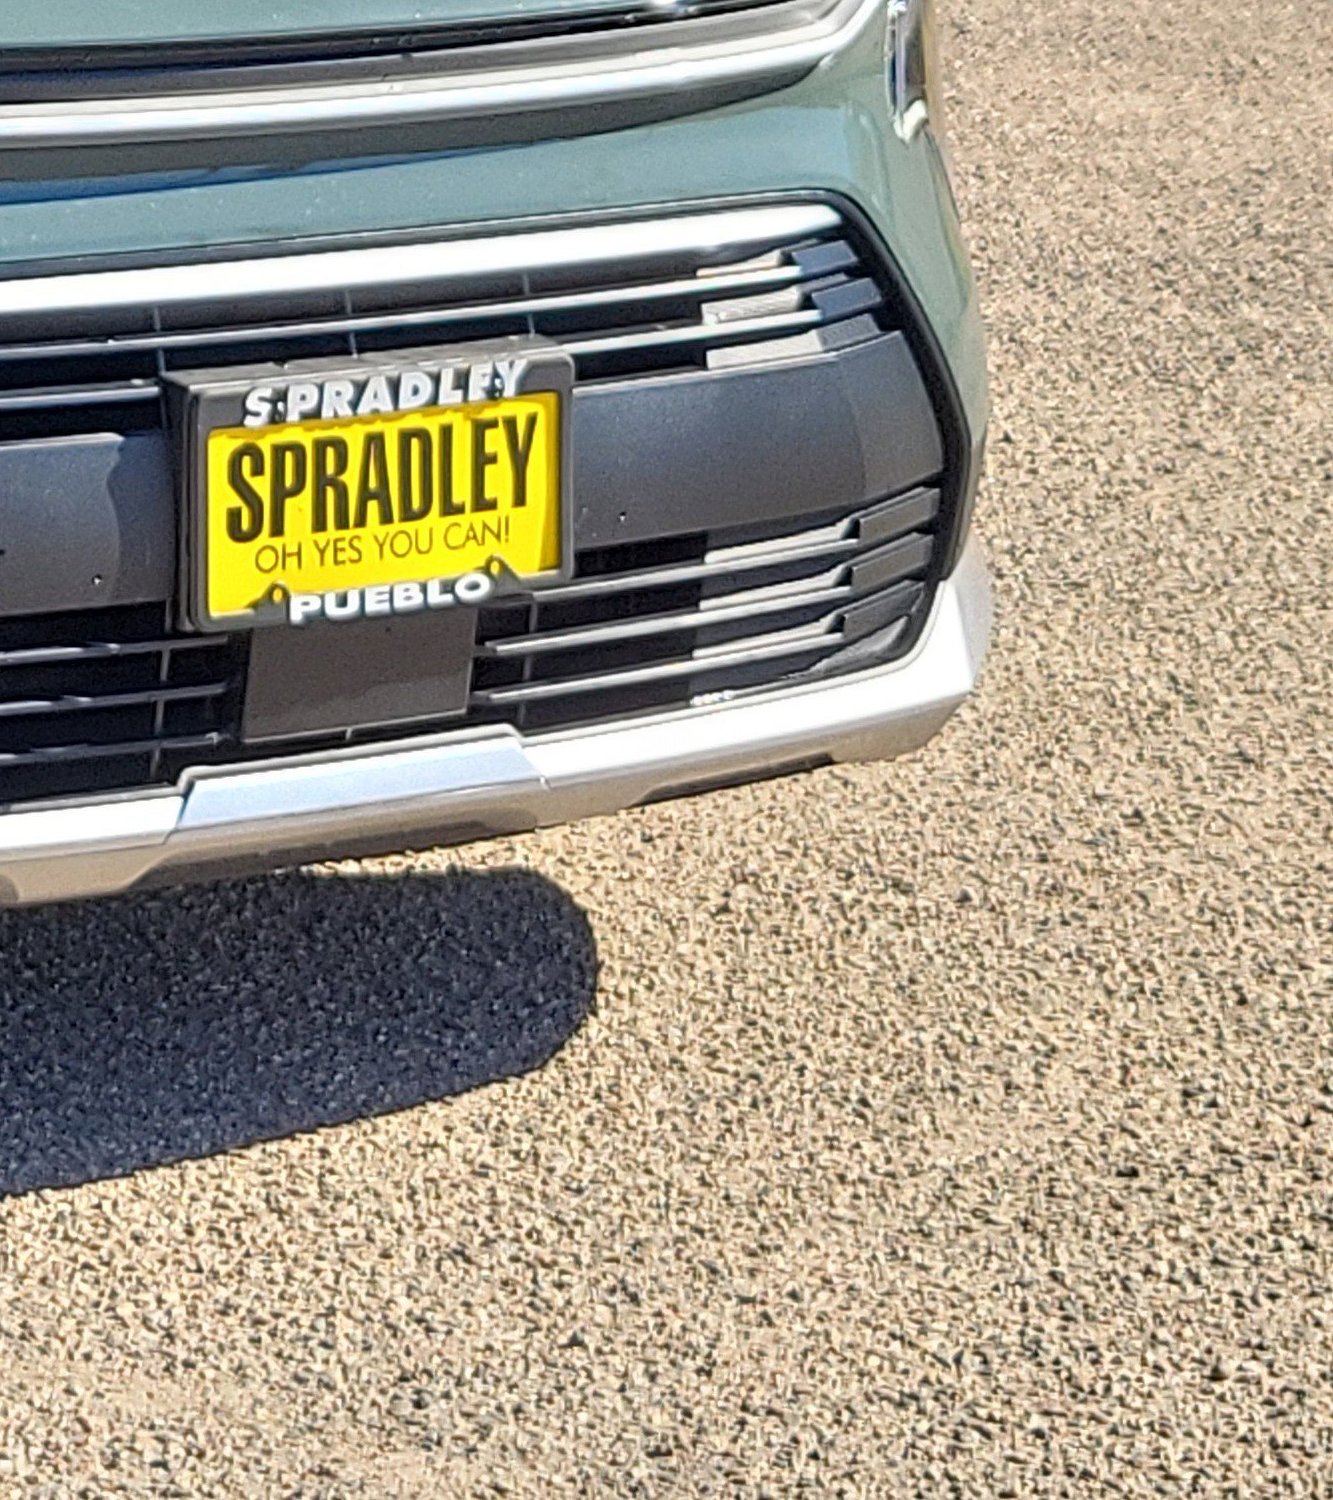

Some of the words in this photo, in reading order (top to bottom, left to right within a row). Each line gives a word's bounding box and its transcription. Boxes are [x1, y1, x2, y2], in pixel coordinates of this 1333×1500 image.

[243, 358, 529, 427] SPRADLEY
[225, 412, 539, 544] SPRADLEY
[254, 542, 303, 575] OH
[313, 534, 363, 568] YES
[373, 526, 434, 561] YOU
[443, 514, 511, 551] CAN!
[289, 573, 492, 625] PUEBLO
